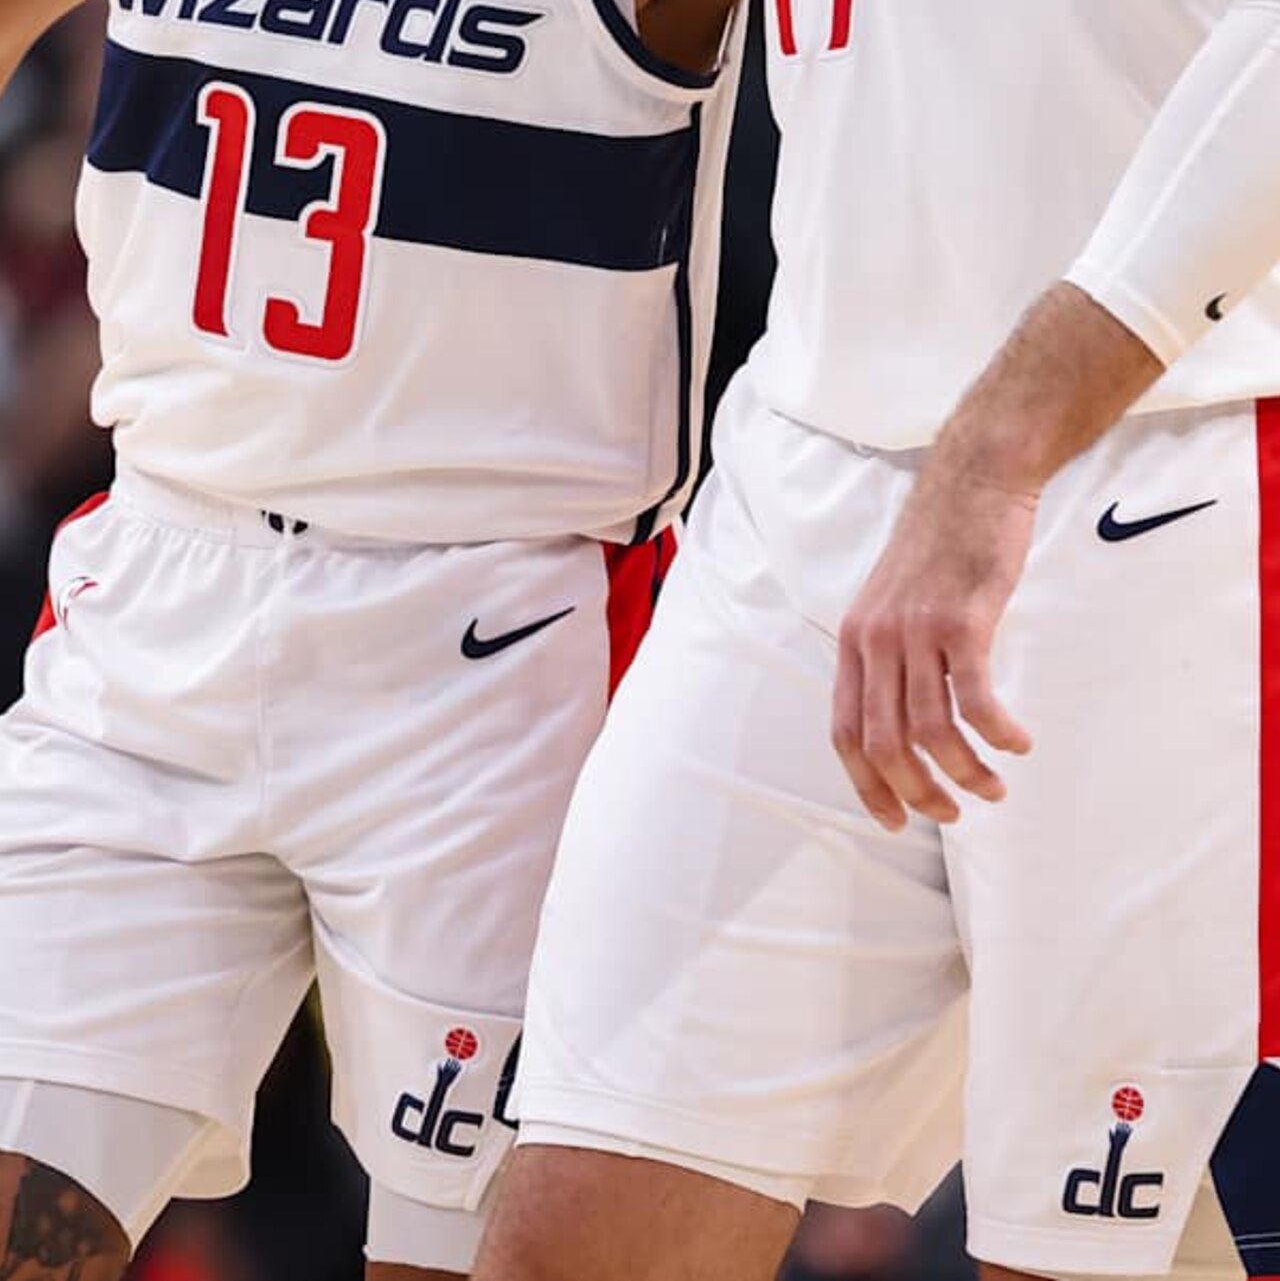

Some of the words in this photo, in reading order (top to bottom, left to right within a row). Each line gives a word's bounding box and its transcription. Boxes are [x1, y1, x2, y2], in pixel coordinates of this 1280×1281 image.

[191, 81, 387, 367] 13
[392, 1057, 484, 1158] dc
[1062, 1122, 1164, 1219] dc
